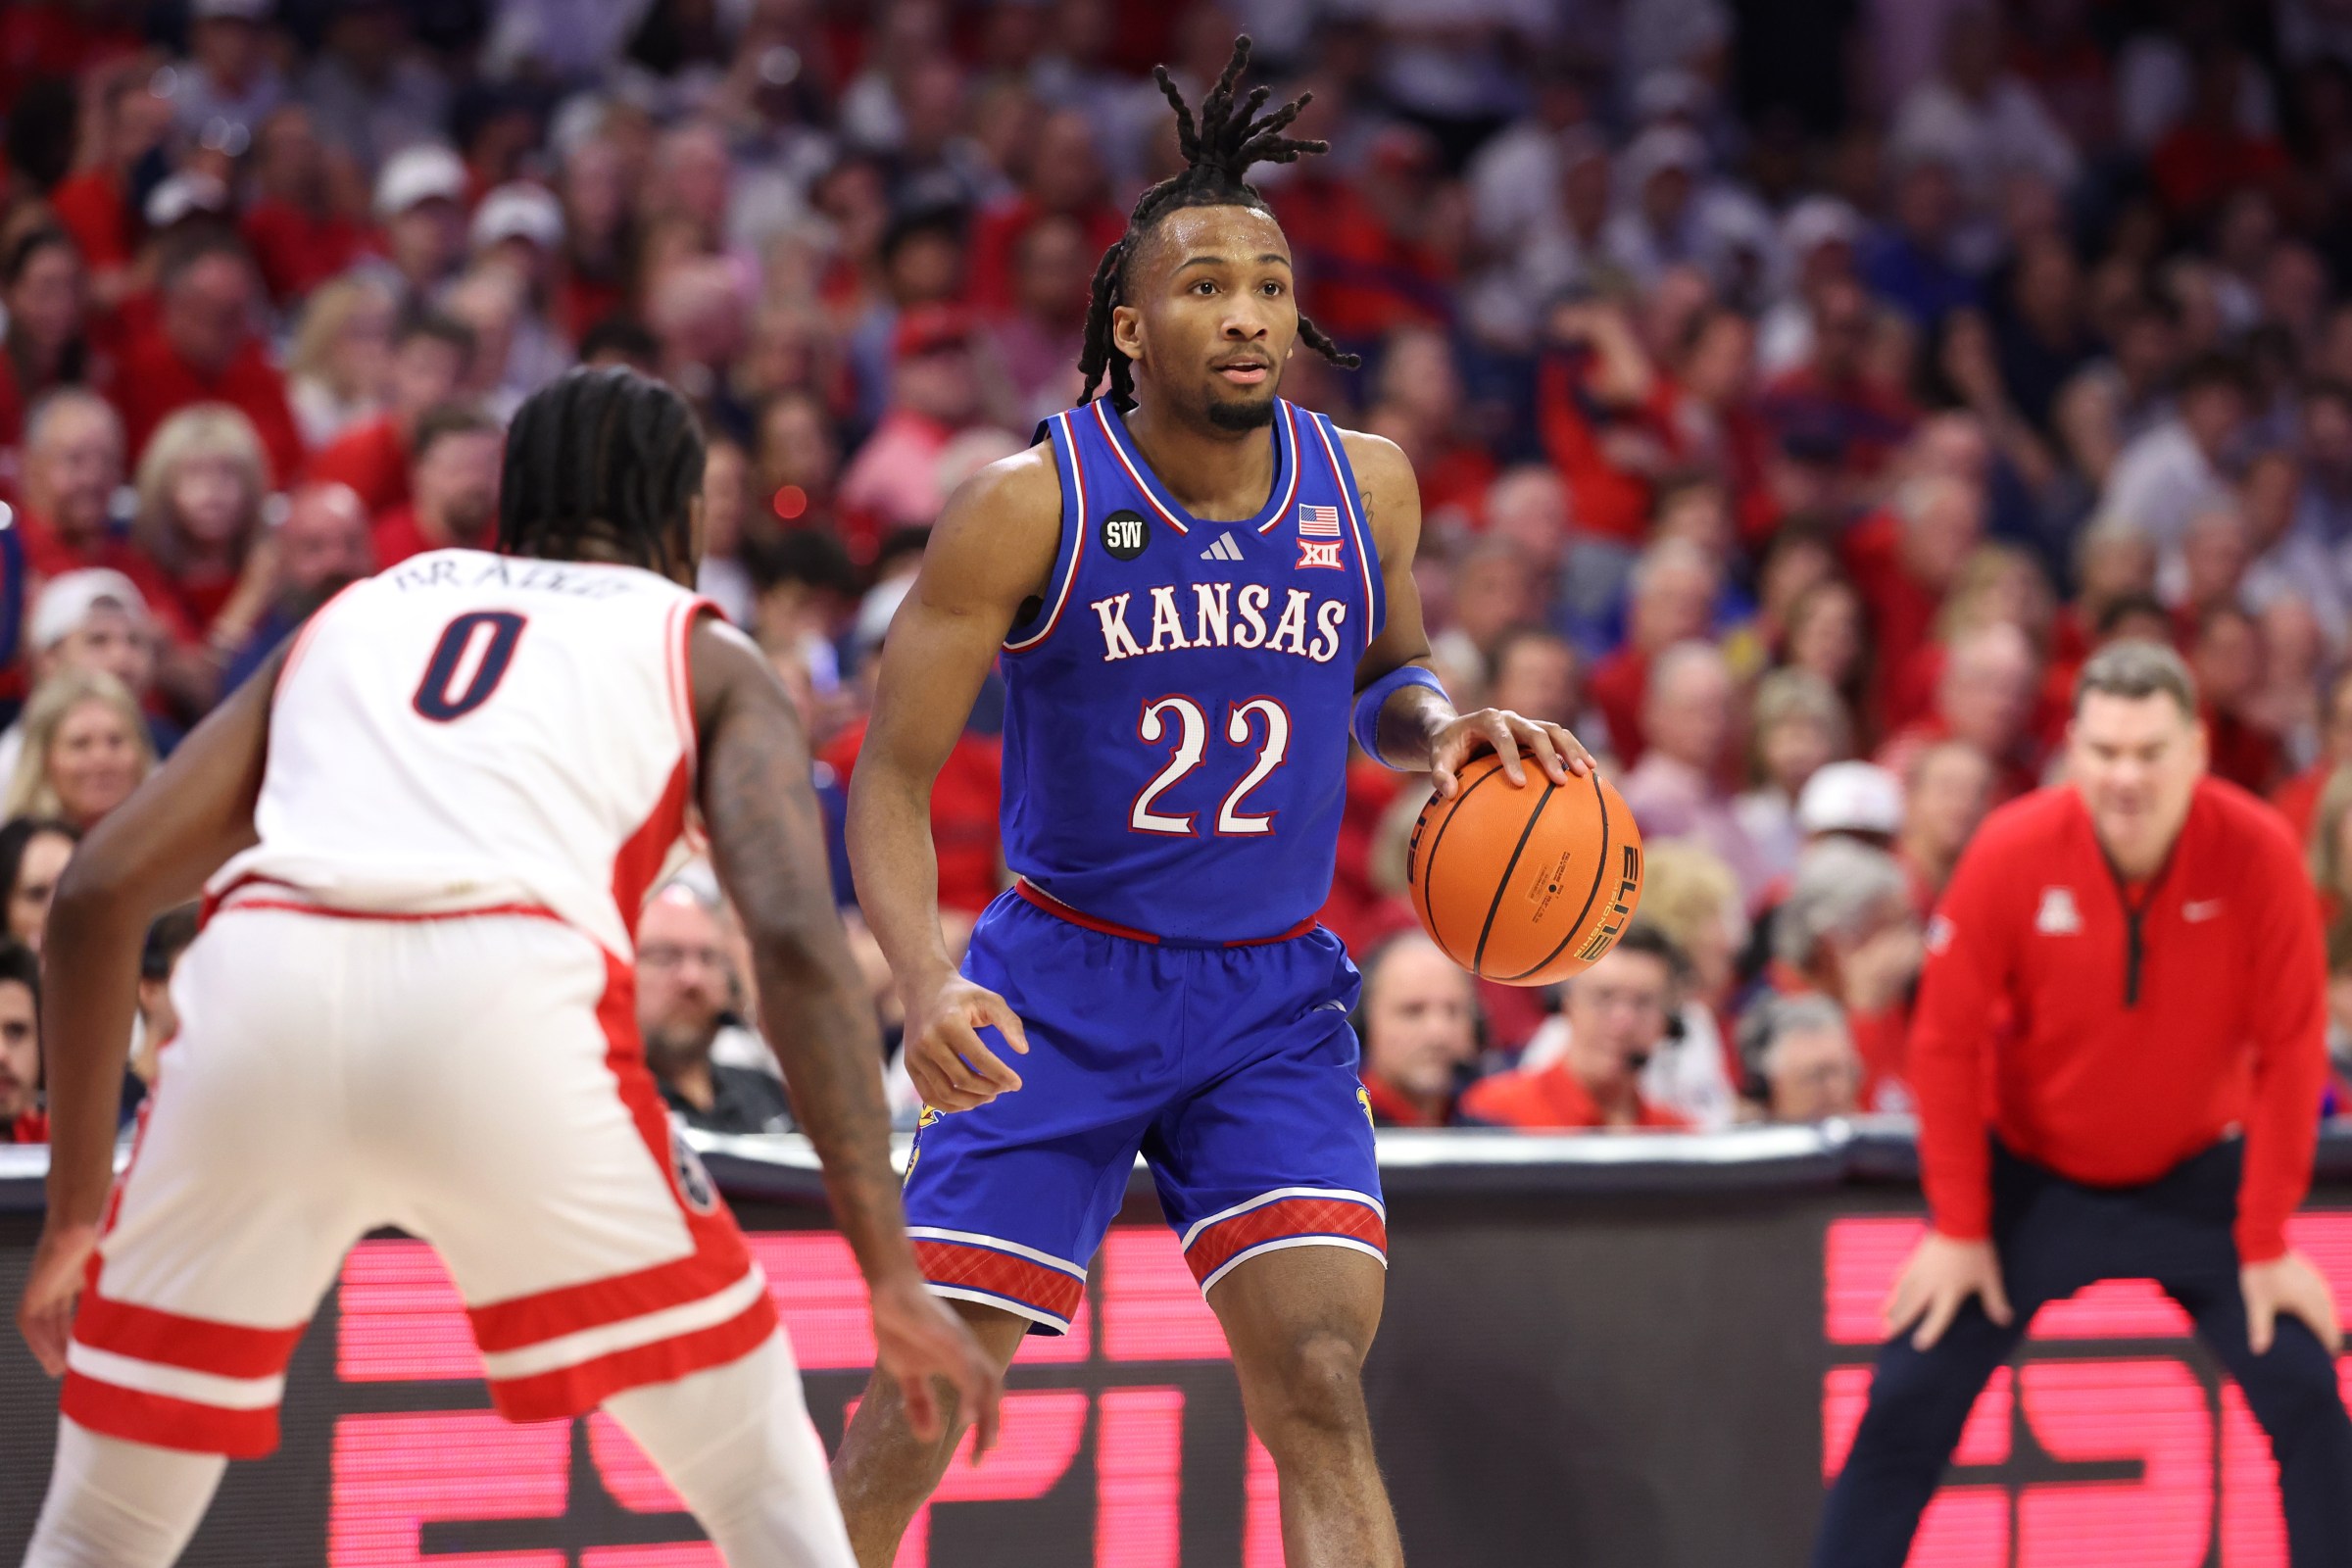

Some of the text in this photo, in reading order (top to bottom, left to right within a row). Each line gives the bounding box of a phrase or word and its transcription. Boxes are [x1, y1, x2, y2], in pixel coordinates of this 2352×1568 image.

[1105, 520, 1144, 549] SW
[1298, 541, 1343, 568] XII
[413, 609, 529, 725] 0
[1091, 582, 1348, 662] KANSAS
[1128, 693, 1293, 839] 22
[1574, 844, 1623, 957] MPIONSHIP
[1579, 846, 1639, 960] ELITE
